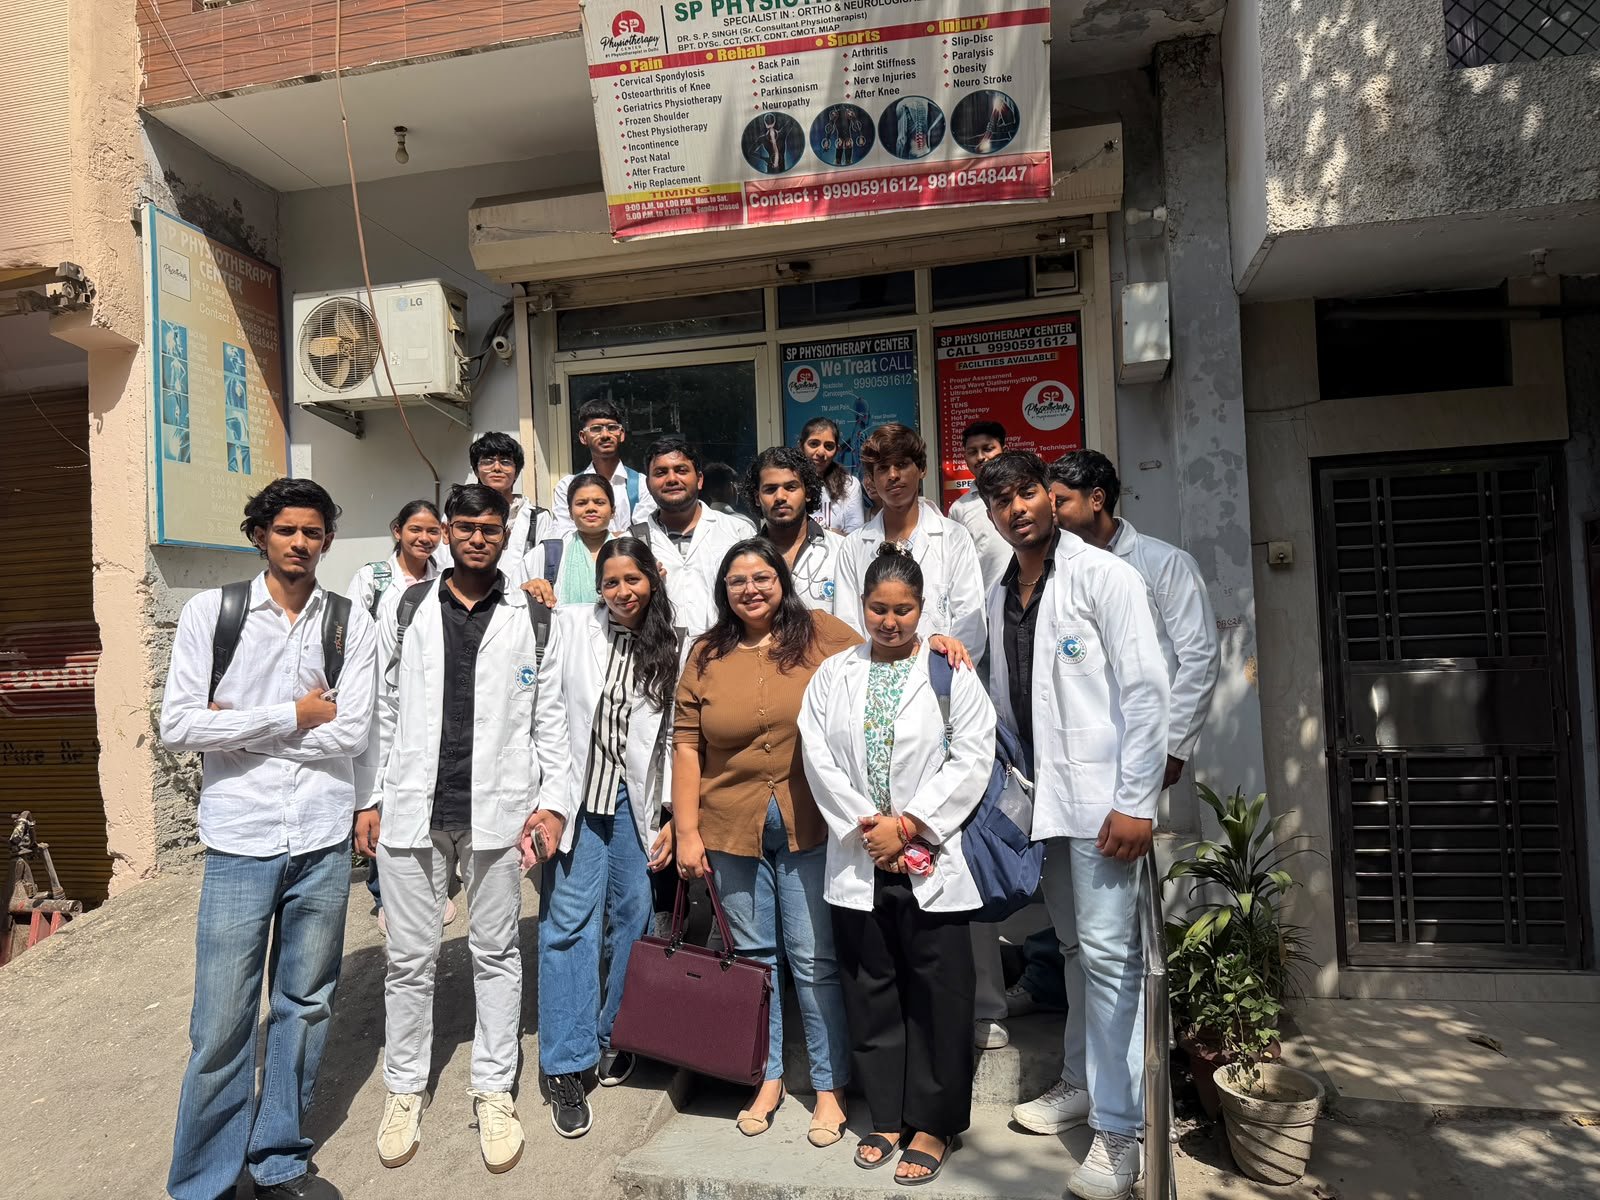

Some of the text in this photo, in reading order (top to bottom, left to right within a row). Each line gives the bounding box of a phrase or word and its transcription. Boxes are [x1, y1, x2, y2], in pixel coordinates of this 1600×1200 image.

[674, 0, 703, 22] SP
[723, 12, 777, 27] SPECIALIST
[780, 10, 789, 20] IN
[798, 4, 832, 17] ORTHO
[834, 3, 841, 12] &
[619, 18, 640, 34] SP
[677, 34, 690, 43] DR.
[712, 29, 738, 38] SINGH
[739, 27, 753, 36] (Sr.
[755, 21, 799, 33] Consultant
[800, 12, 868, 26] Physiotherapist)
[818, 24, 840, 33] MIAP
[938, 16, 989, 33] Injury
[600, 34, 660, 53] Physiotherapy
[827, 30, 881, 48] Sports
[951, 33, 994, 48] Slip-Disc
[717, 44, 766, 61] Rehab
[851, 45, 888, 59] Arthritis
[952, 47, 994, 61] Paralysis
[630, 57, 663, 73] Pain
[758, 57, 800, 71] Back Pain
[852, 57, 916, 73] Joint Stiffness
[952, 62, 987, 75] Obesity
[619, 69, 705, 88] Cervical Spondylosis
[760, 72, 794, 84] Sciatica
[853, 71, 917, 87] Nerve Injuries
[953, 74, 1012, 90] Neuro Stroke
[621, 81, 711, 101] Osteoarthritis of Knee
[761, 82, 819, 98] Parkinsonism
[854, 86, 900, 101] After Knee
[623, 94, 723, 114] Geriatrics Physiotherapy
[762, 96, 811, 111] Neuropathy
[625, 111, 690, 127] Frozen Shoulder
[626, 122, 708, 140] Chest Physiotherapy
[628, 139, 680, 152] Incontinence
[630, 152, 670, 165] Post Natal
[631, 164, 685, 178] After Fracture
[633, 175, 702, 191] Hip Replacement
[749, 190, 809, 209] Contact
[823, 176, 923, 201] 9990591612,
[928, 166, 1029, 188] 9810548447
[650, 186, 711, 199] TIMING
[656, 201, 664, 209] to
[696, 203, 718, 214] Sunday
[720, 202, 740, 211] Closed
[180, 230, 272, 289] PHYSIOTHERAPY
[199, 260, 243, 295] CENTER
[410, 297, 423, 307] LG
[199, 302, 230, 324] Contact
[940, 322, 1073, 347] SP PHYSIOTHERAPY CENTER
[786, 336, 910, 361] SP PHYSIOTHERAPY CENTER
[946, 335, 1069, 358] CALL 9990591612
[820, 354, 911, 377] We Treat CALL
[958, 352, 1056, 370] FACILITIES AVAILABLE
[853, 373, 912, 390] 9990591612
[949, 372, 1012, 386] Proper Assessment
[949, 383, 967, 392] Long
[968, 381, 985, 389] Wave
[950, 385, 1011, 397] Ultrasonic Therapy
[1042, 391, 1060, 402] SP
[950, 401, 969, 409] TENS
[950, 407, 990, 417] Cryotherapy
[964, 413, 980, 421] Pack
[1008, 440, 1035, 449] Training
[1039, 443, 1077, 453] Techniques
